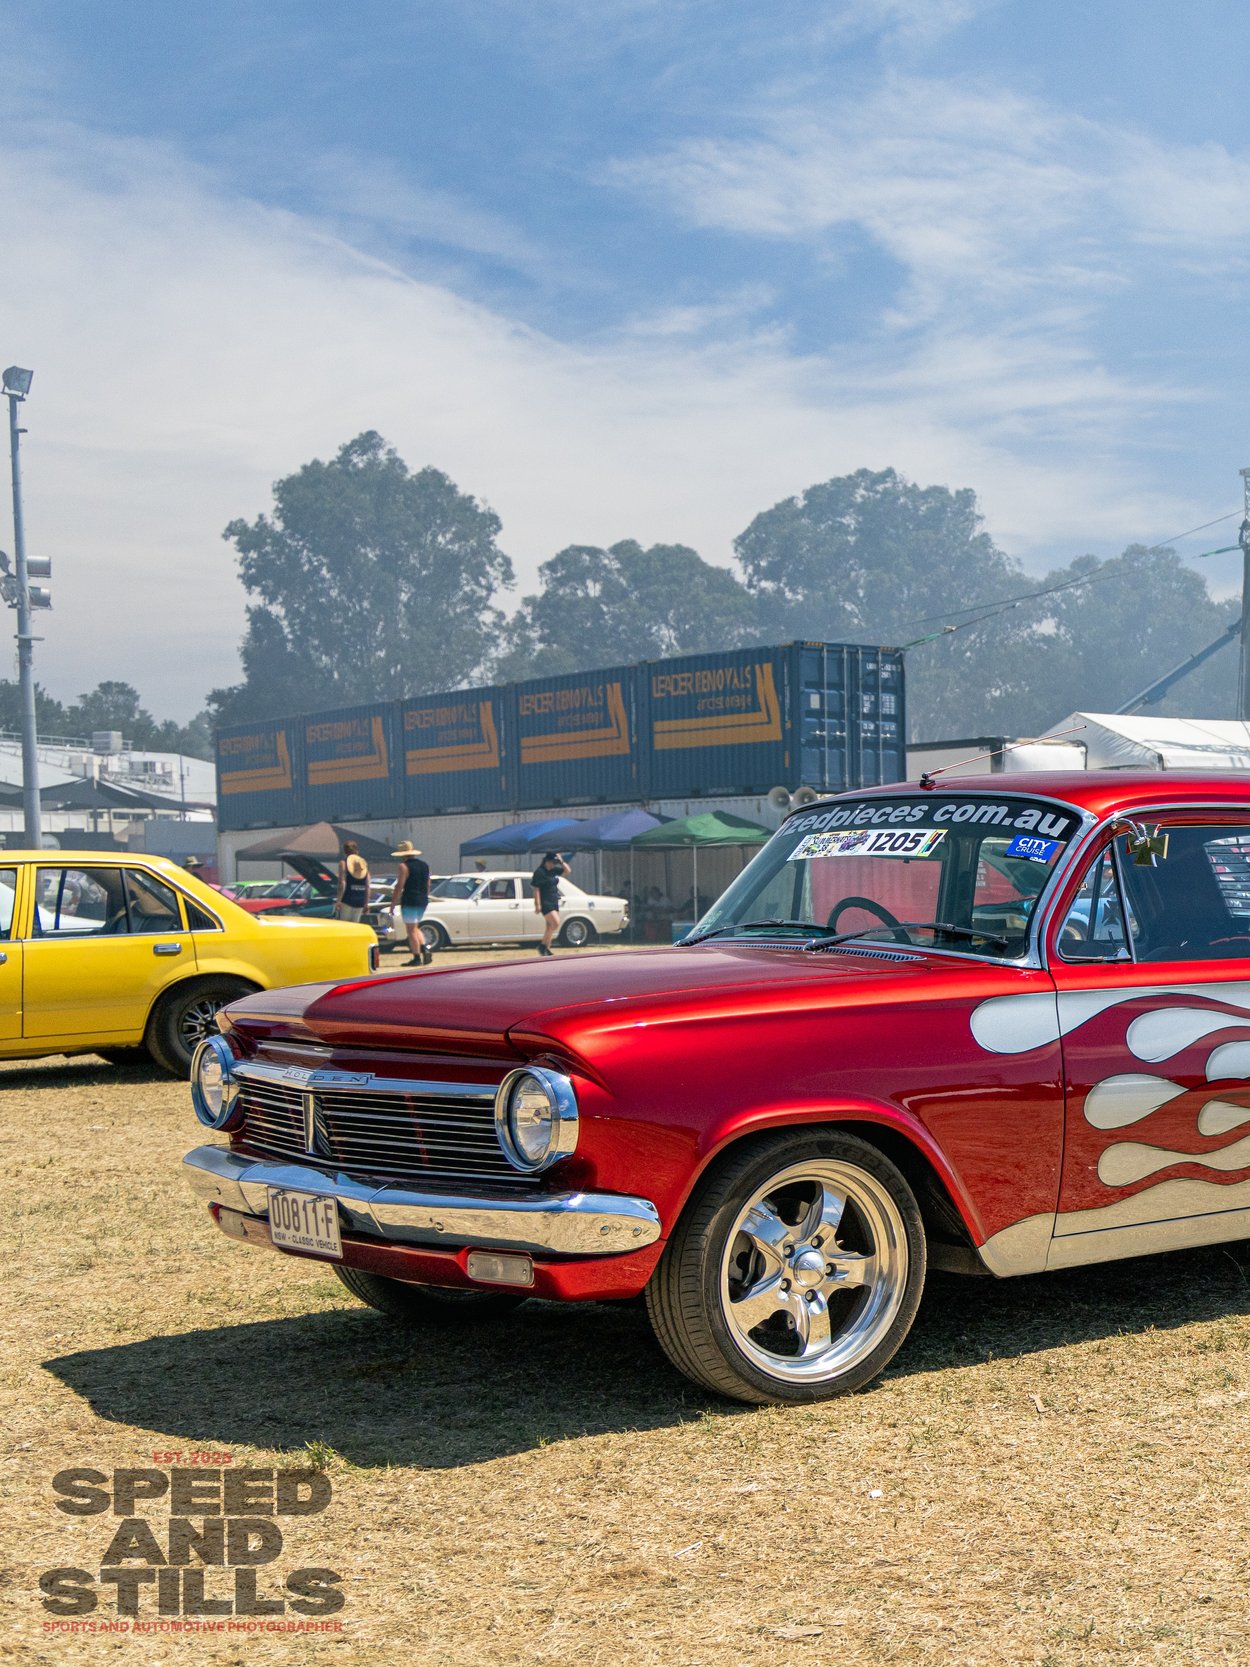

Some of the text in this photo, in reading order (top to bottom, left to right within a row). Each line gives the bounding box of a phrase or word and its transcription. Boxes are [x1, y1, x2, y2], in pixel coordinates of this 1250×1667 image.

[779, 804, 1070, 839] izedpieces com.au
[866, 832, 927, 852] 1205
[1015, 845, 1045, 856] CRUISE
[1018, 838, 1051, 850] CITY
[274, 1231, 338, 1252] NSW CLASSIC VEHICLE
